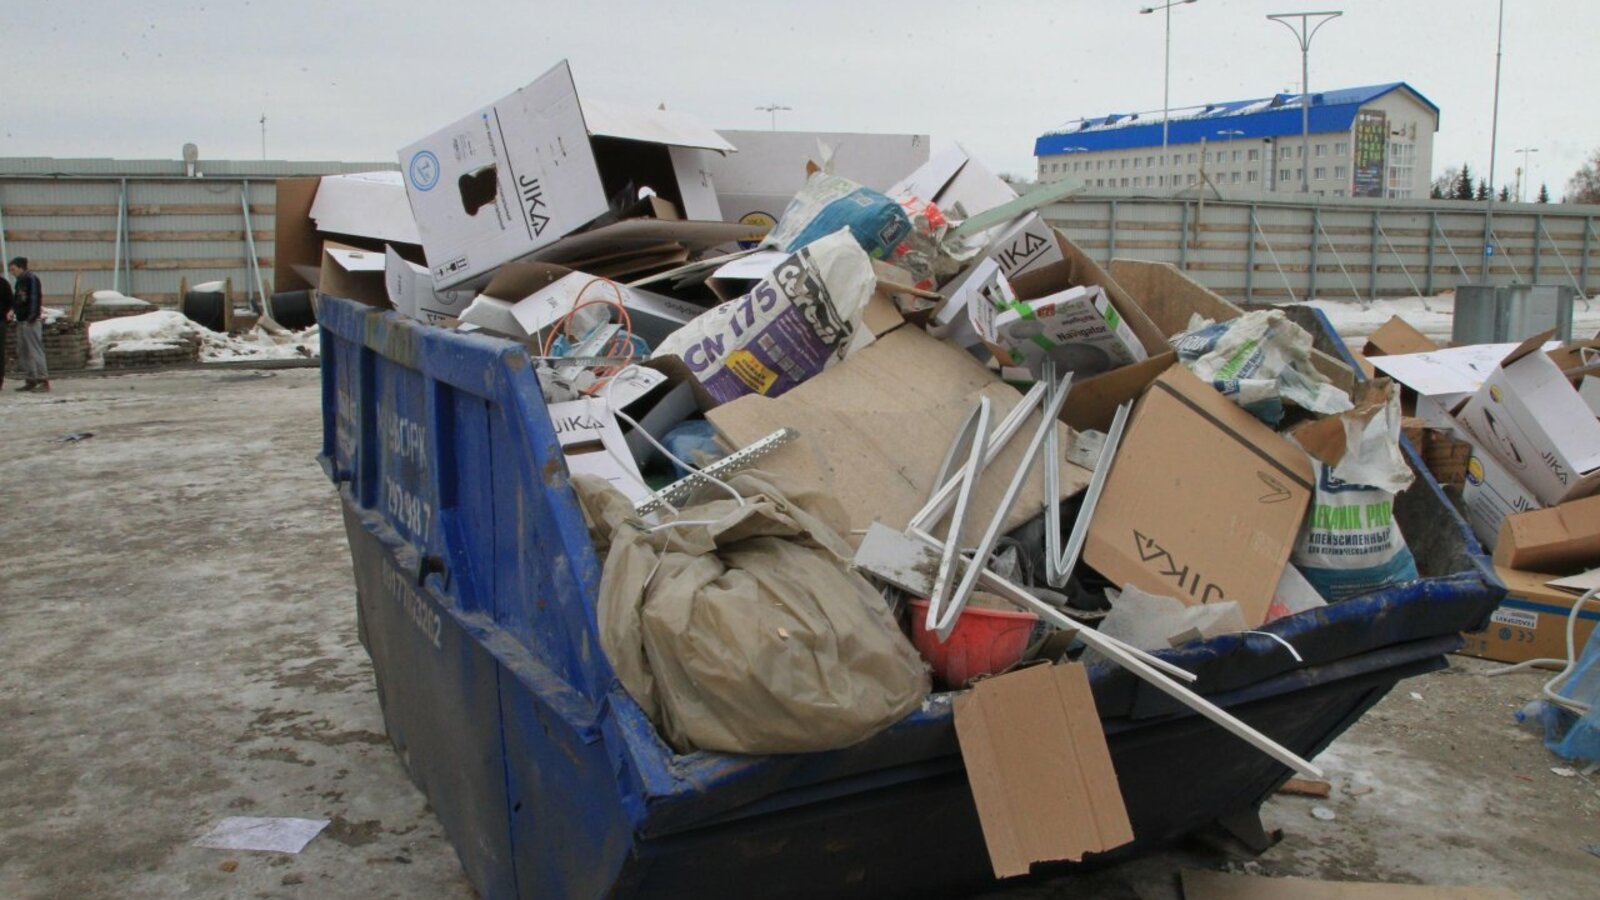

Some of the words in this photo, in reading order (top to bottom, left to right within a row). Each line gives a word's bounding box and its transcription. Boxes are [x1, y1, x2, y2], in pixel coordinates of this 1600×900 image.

[519, 175, 550, 237] JIKA
[684, 332, 724, 373] CN
[728, 281, 778, 337] 175
[1056, 325, 1107, 341] Navigator
[555, 415, 605, 433] JIKA
[1541, 451, 1568, 485] JIKA
[1133, 528, 1224, 604] JIKA
